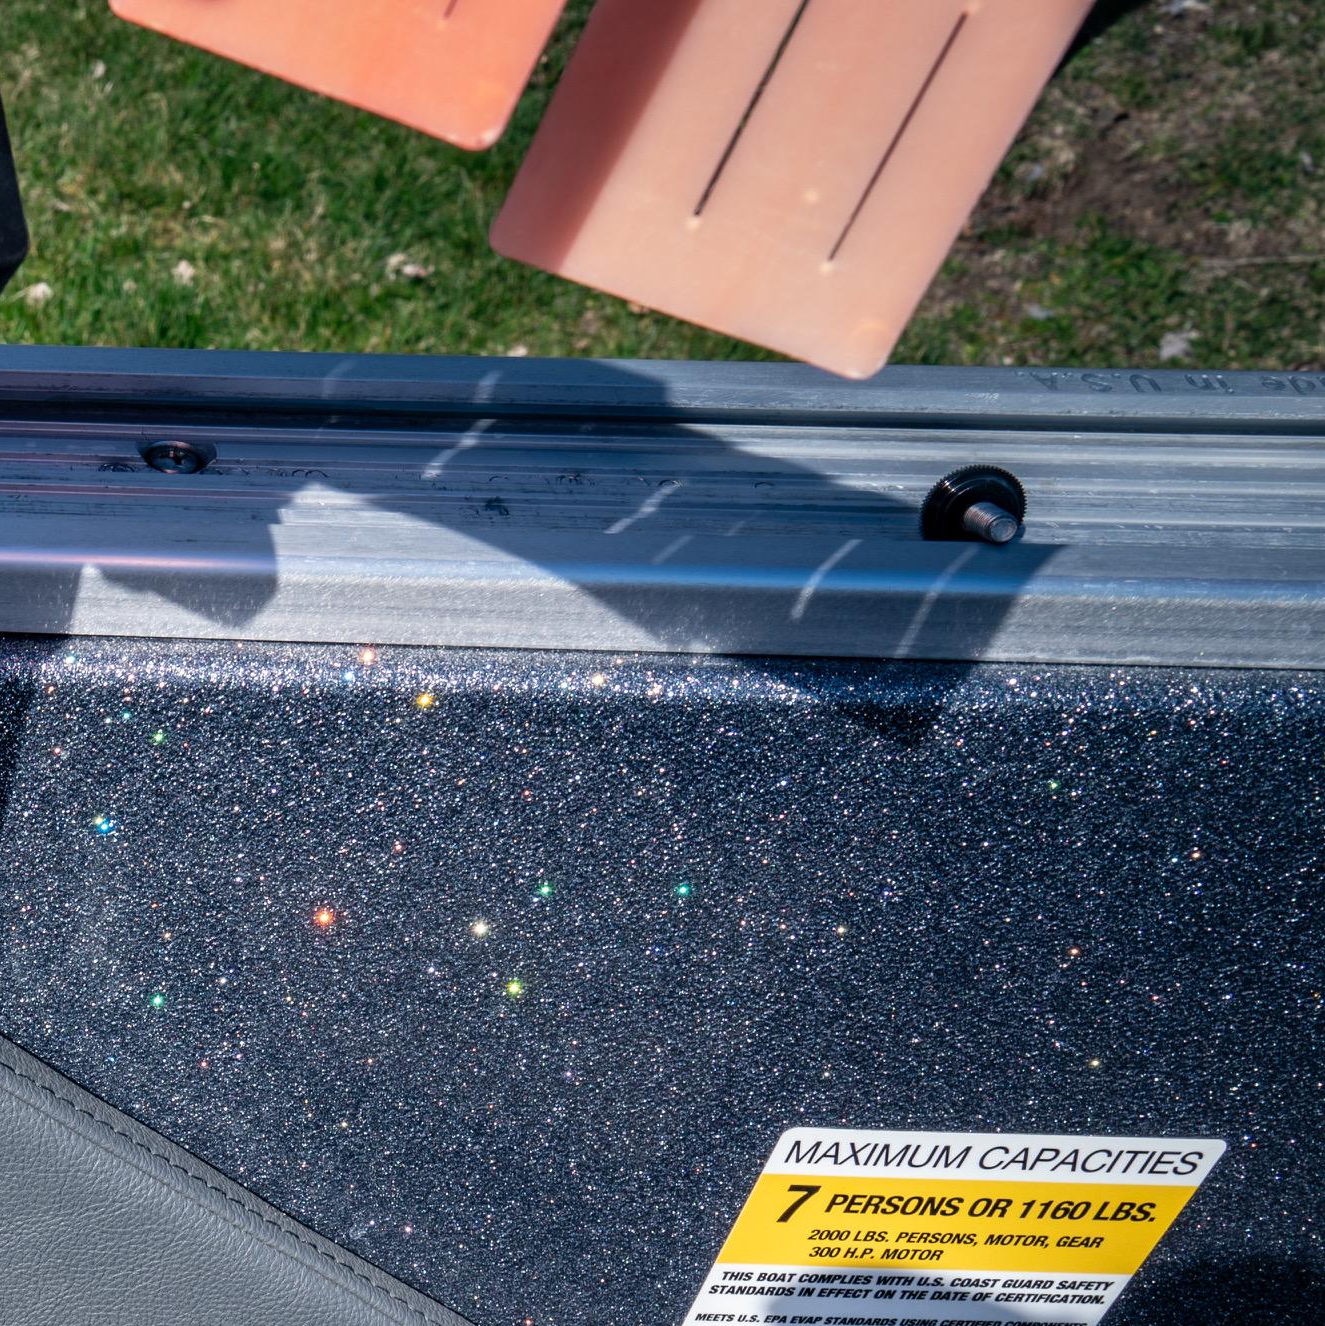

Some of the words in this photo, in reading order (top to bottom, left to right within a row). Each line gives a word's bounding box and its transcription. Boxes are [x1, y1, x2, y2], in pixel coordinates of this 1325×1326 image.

[784, 1140, 972, 1169] MAXIMUM
[978, 1146, 1204, 1176] CAPACITIES
[776, 1184, 822, 1223] 7
[824, 1193, 964, 1217] PERSONS
[967, 1197, 1013, 1218] OR
[1019, 1199, 1092, 1221] 1160
[1092, 1201, 1157, 1222] LBS.
[808, 1229, 851, 1241] 2000
[853, 1230, 890, 1243] LBS.
[895, 1231, 978, 1247] PERSONS,
[984, 1234, 1050, 1249] MOTOR,
[1056, 1236, 1105, 1249] GEAR
[808, 1247, 841, 1259] 300
[843, 1248, 875, 1260] H.P.
[880, 1249, 944, 1261] MOTOR
[721, 1271, 753, 1282] THIS
[756, 1272, 797, 1283] BOAT
[799, 1273, 873, 1286] COMPLIES
[876, 1276, 915, 1286] WITH
[917, 1276, 946, 1287] U.S.
[950, 1277, 1002, 1289] COAST
[1001, 1278, 1055, 1290] GUARD
[1056, 1280, 1114, 1291] SAFETY
[708, 1284, 796, 1297] STANDARDS
[797, 1287, 815, 1298] IN
[817, 1287, 872, 1299] EFFECT
[873, 1288, 896, 1300] ON
[900, 1290, 929, 1300] THE
[929, 1290, 971, 1301] DATE
[972, 1291, 994, 1302] OF
[995, 1292, 1106, 1305] CERTIFICATION.
[695, 1313, 735, 1323] MEETS
[737, 1314, 761, 1323] U.S.
[763, 1315, 787, 1324] EPA
[790, 1316, 822, 1325] EVAP
[824, 1316, 897, 1326] STANDARDS
